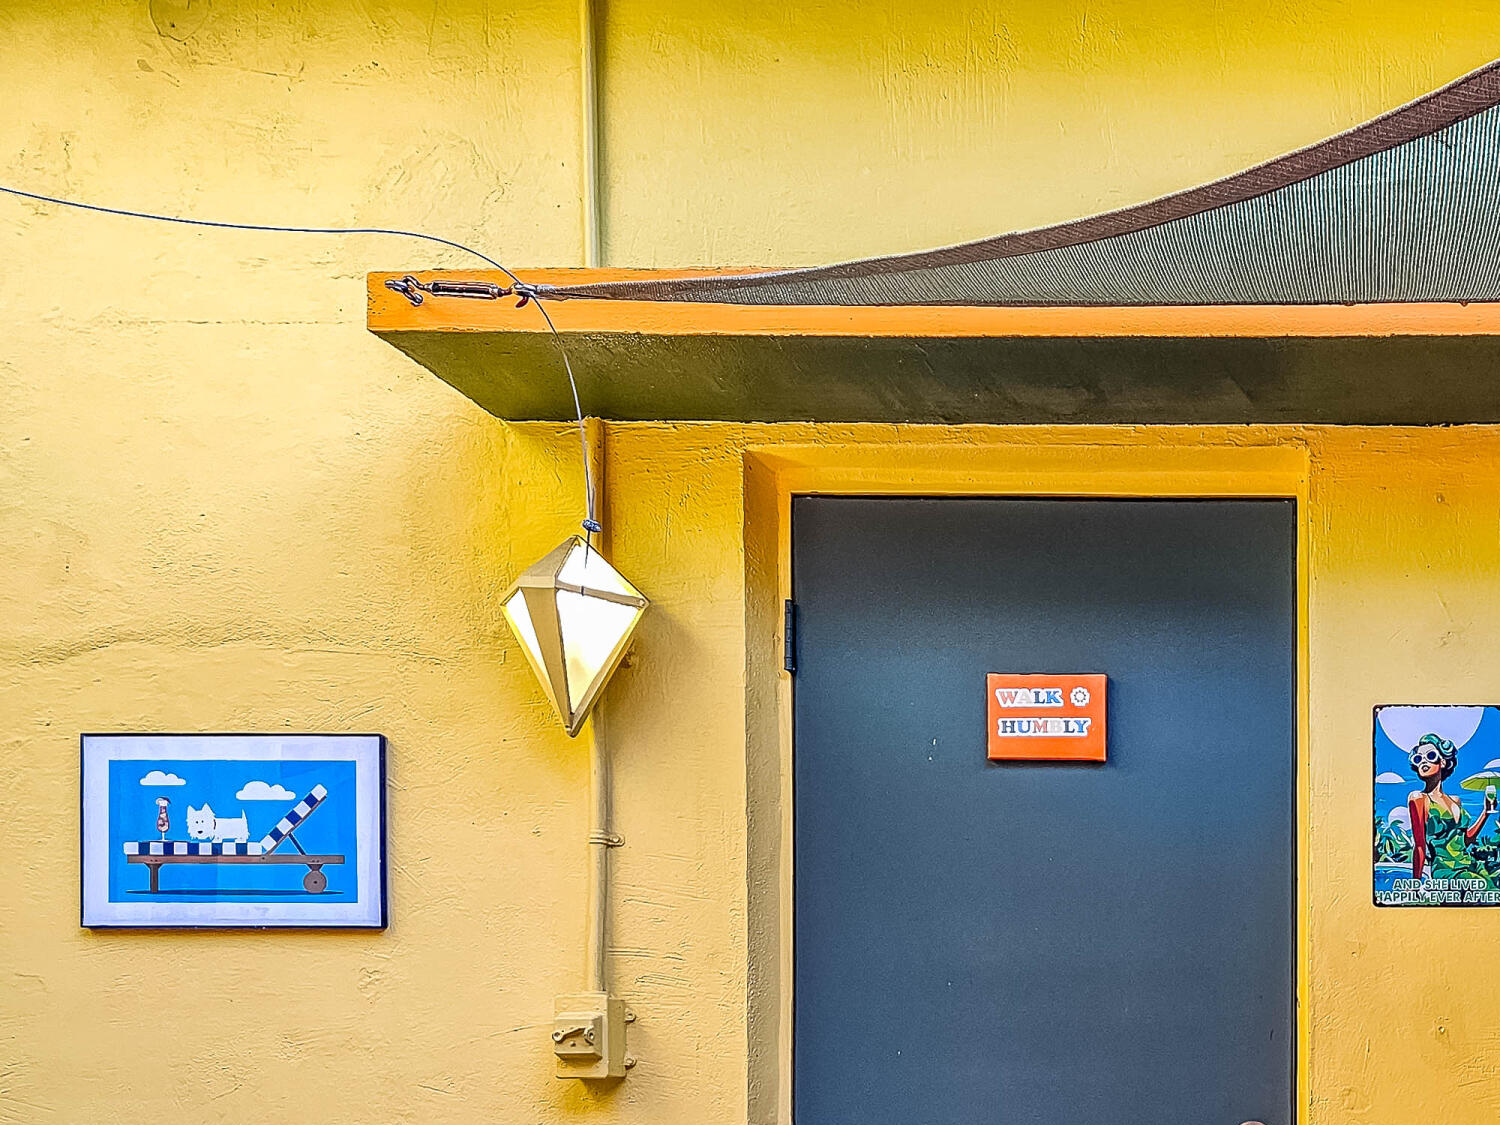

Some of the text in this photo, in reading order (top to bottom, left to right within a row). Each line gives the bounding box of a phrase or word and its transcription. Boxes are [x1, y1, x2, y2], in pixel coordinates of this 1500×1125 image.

[998, 690, 1061, 704] WALK
[1001, 720, 1088, 734] HUMBLY
[1393, 880, 1486, 891] AND SHE LIVED
[1375, 891, 1500, 902] HAPPILY EVER AFTER
